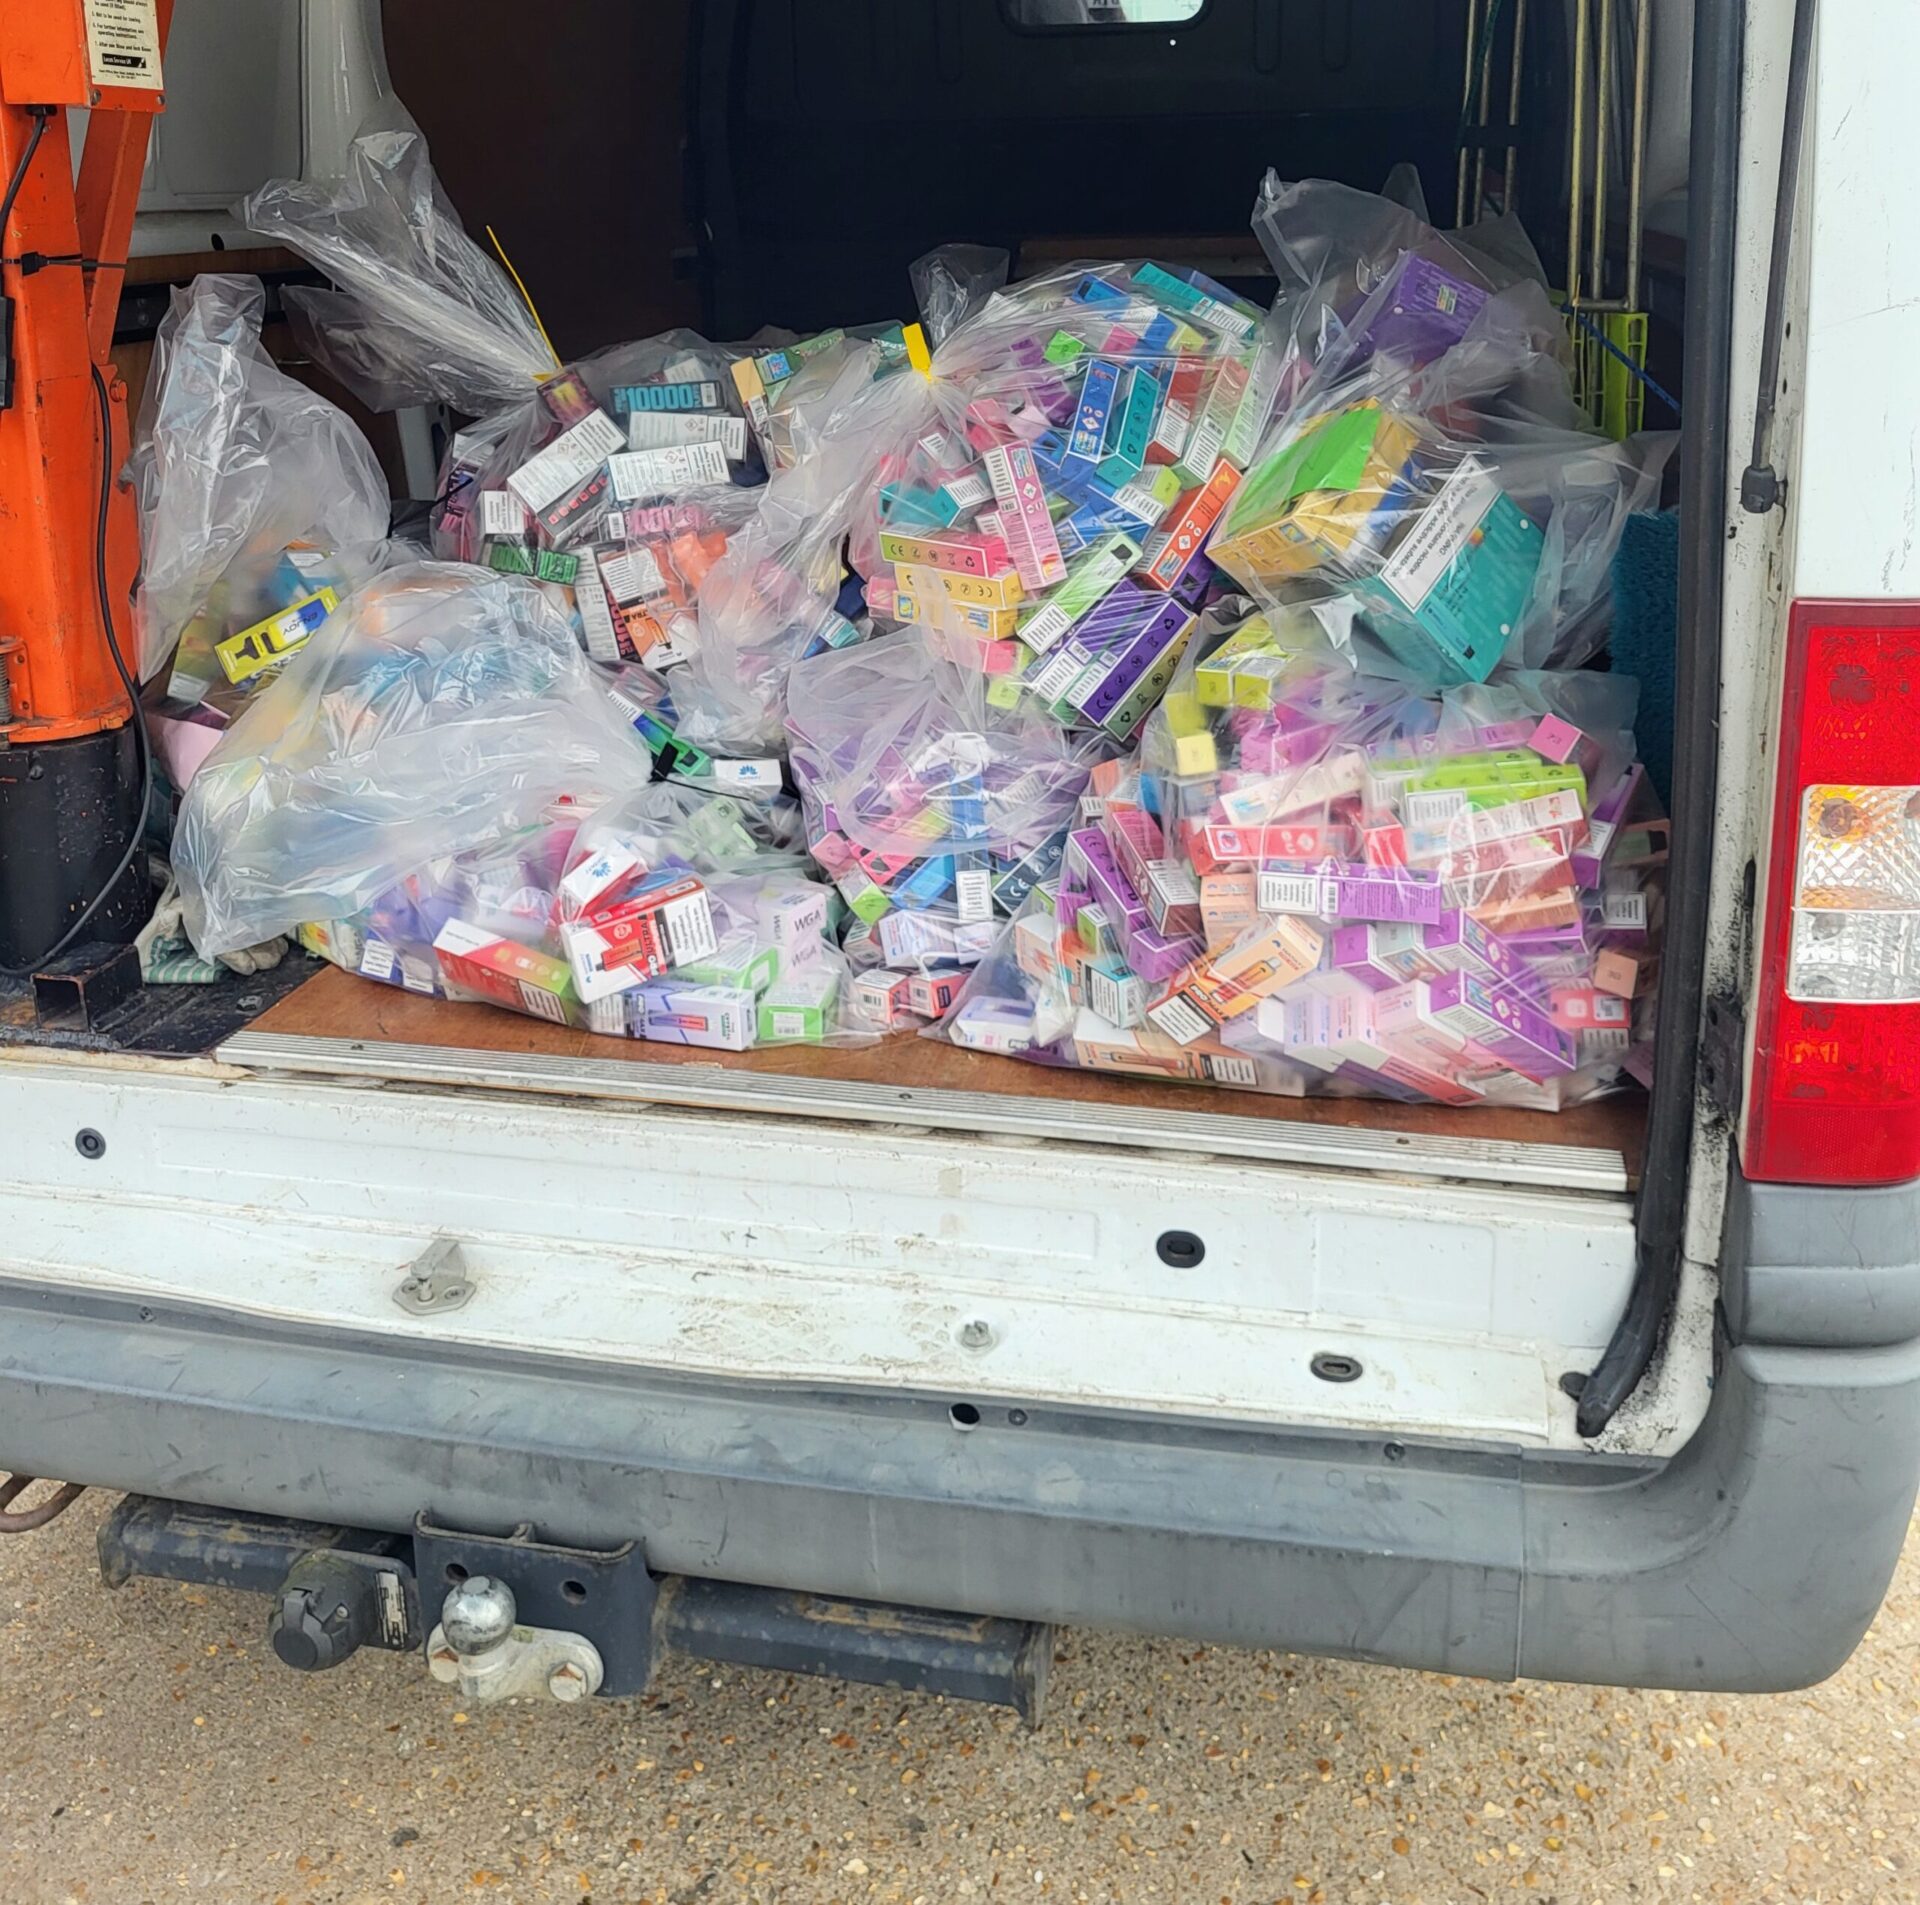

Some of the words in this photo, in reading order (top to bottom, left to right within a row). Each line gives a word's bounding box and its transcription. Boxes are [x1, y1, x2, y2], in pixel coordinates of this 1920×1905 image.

[626, 384, 693, 411] 10000
[281, 610, 318, 636] ENJOY
[794, 909, 822, 932] WGA
